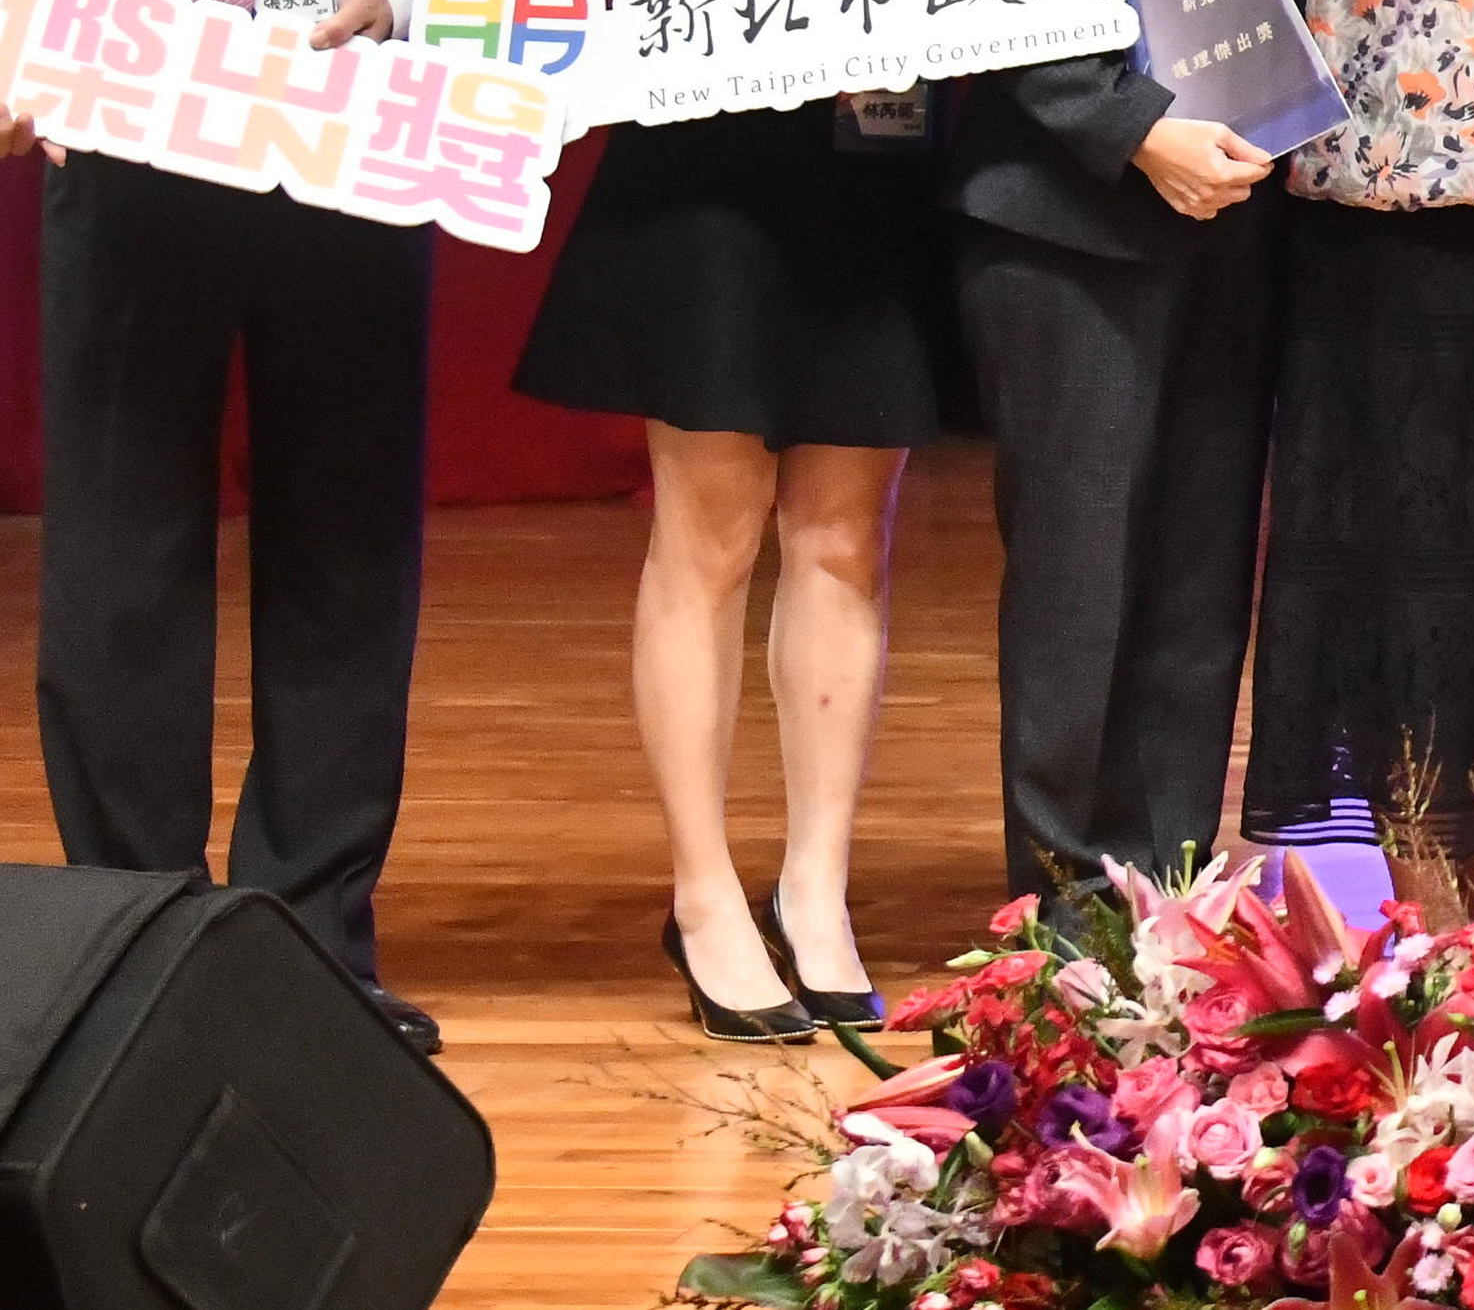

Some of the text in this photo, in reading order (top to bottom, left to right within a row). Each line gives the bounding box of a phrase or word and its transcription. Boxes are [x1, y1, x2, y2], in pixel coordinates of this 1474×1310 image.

[647, 18, 1124, 110] New Taipei City Government
